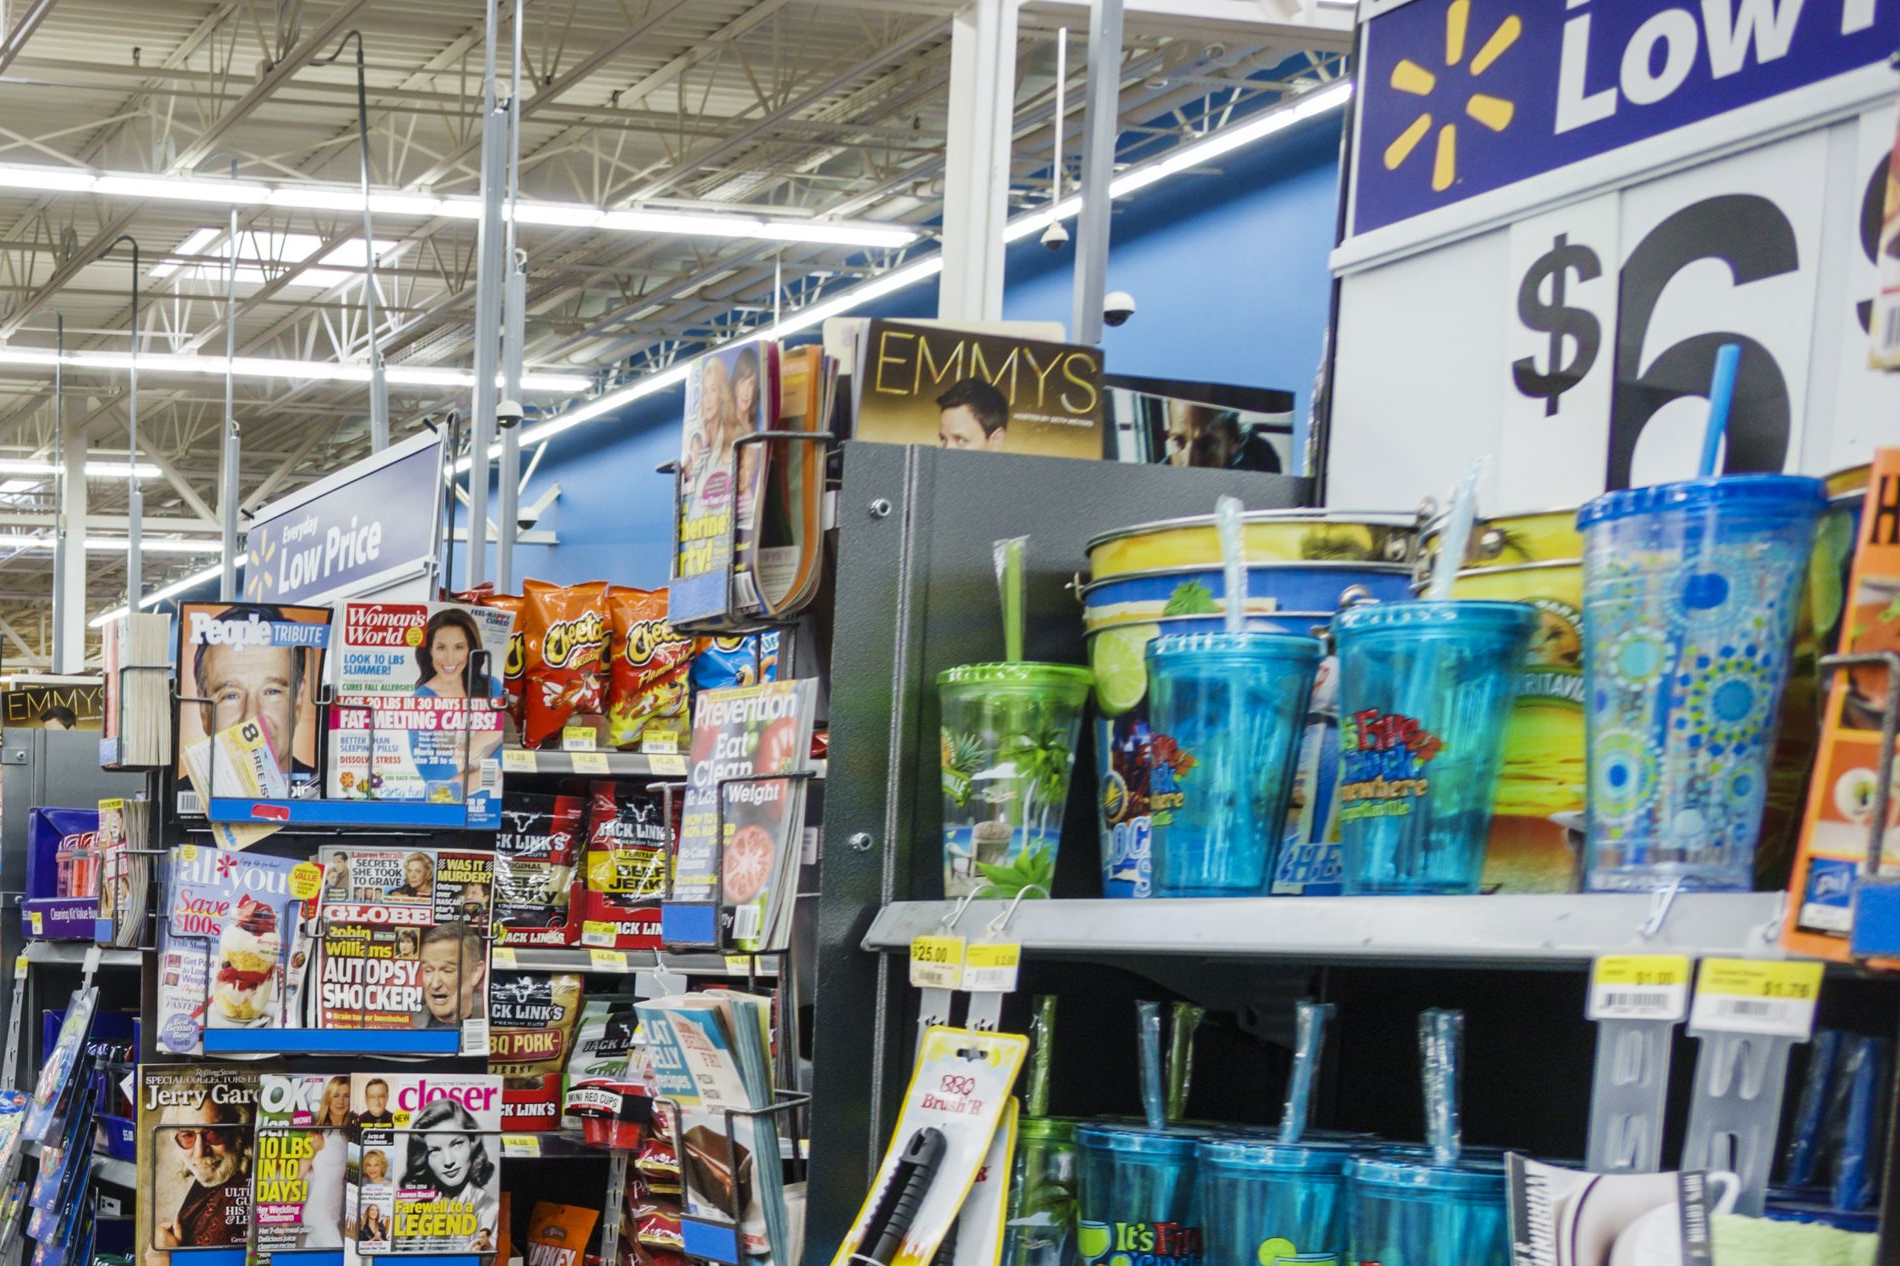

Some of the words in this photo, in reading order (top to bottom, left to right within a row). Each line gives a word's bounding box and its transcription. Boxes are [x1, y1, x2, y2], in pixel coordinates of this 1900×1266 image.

[1556, 0, 1802, 135] Low
[875, 330, 1098, 414] EMMYS
[282, 515, 318, 541] Everyday
[278, 546, 323, 594] Low
[324, 515, 381, 577] Price
[349, 606, 425, 627] Woman's
[189, 614, 272, 650] People
[273, 623, 323, 645] TRIBUTE
[348, 627, 403, 644] World
[344, 655, 371, 664] LOOK
[375, 655, 384, 664] 10
[388, 656, 404, 664] LBS
[344, 665, 391, 675] SLIMMER!
[384, 698, 401, 710] LBS
[404, 698, 415, 710] IN
[434, 698, 459, 710] DAYS
[694, 692, 798, 729] Prevention
[715, 733, 749, 761] Eat
[693, 760, 753, 788] Clean
[729, 784, 780, 804] Weight
[352, 869, 372, 877] SHE
[376, 869, 402, 877] TOOK
[447, 860, 471, 871] WAS
[473, 860, 484, 871] IT
[225, 868, 286, 897] you
[354, 877, 366, 885] TO
[369, 878, 402, 887] GRAVE
[438, 870, 492, 883] MURDER?
[179, 889, 230, 916] Save
[323, 906, 432, 924] GLOBE
[175, 916, 221, 936] $100s
[326, 941, 391, 958] Williams
[323, 958, 420, 985] AUTOPSY
[323, 985, 423, 1012] SHOCKER!
[261, 1078, 324, 1112] OK!
[940, 1074, 975, 1096] BBQ
[146, 1085, 207, 1110] Jerry
[398, 1080, 497, 1112] closer
[568, 1091, 583, 1104] MINI
[585, 1092, 599, 1104] RED
[601, 1094, 619, 1108] CUPS
[395, 1113, 409, 1122] NEW
[259, 1138, 280, 1158] 10
[282, 1138, 314, 1158] LBS
[258, 1160, 276, 1180] IN
[279, 1160, 298, 1180] 10
[257, 1181, 308, 1202] DAYS!
[396, 1201, 447, 1214] Farewell
[451, 1202, 462, 1213] to
[465, 1203, 473, 1212] a
[394, 1214, 477, 1236] LEGEND
[1116, 1221, 1154, 1254] It's
